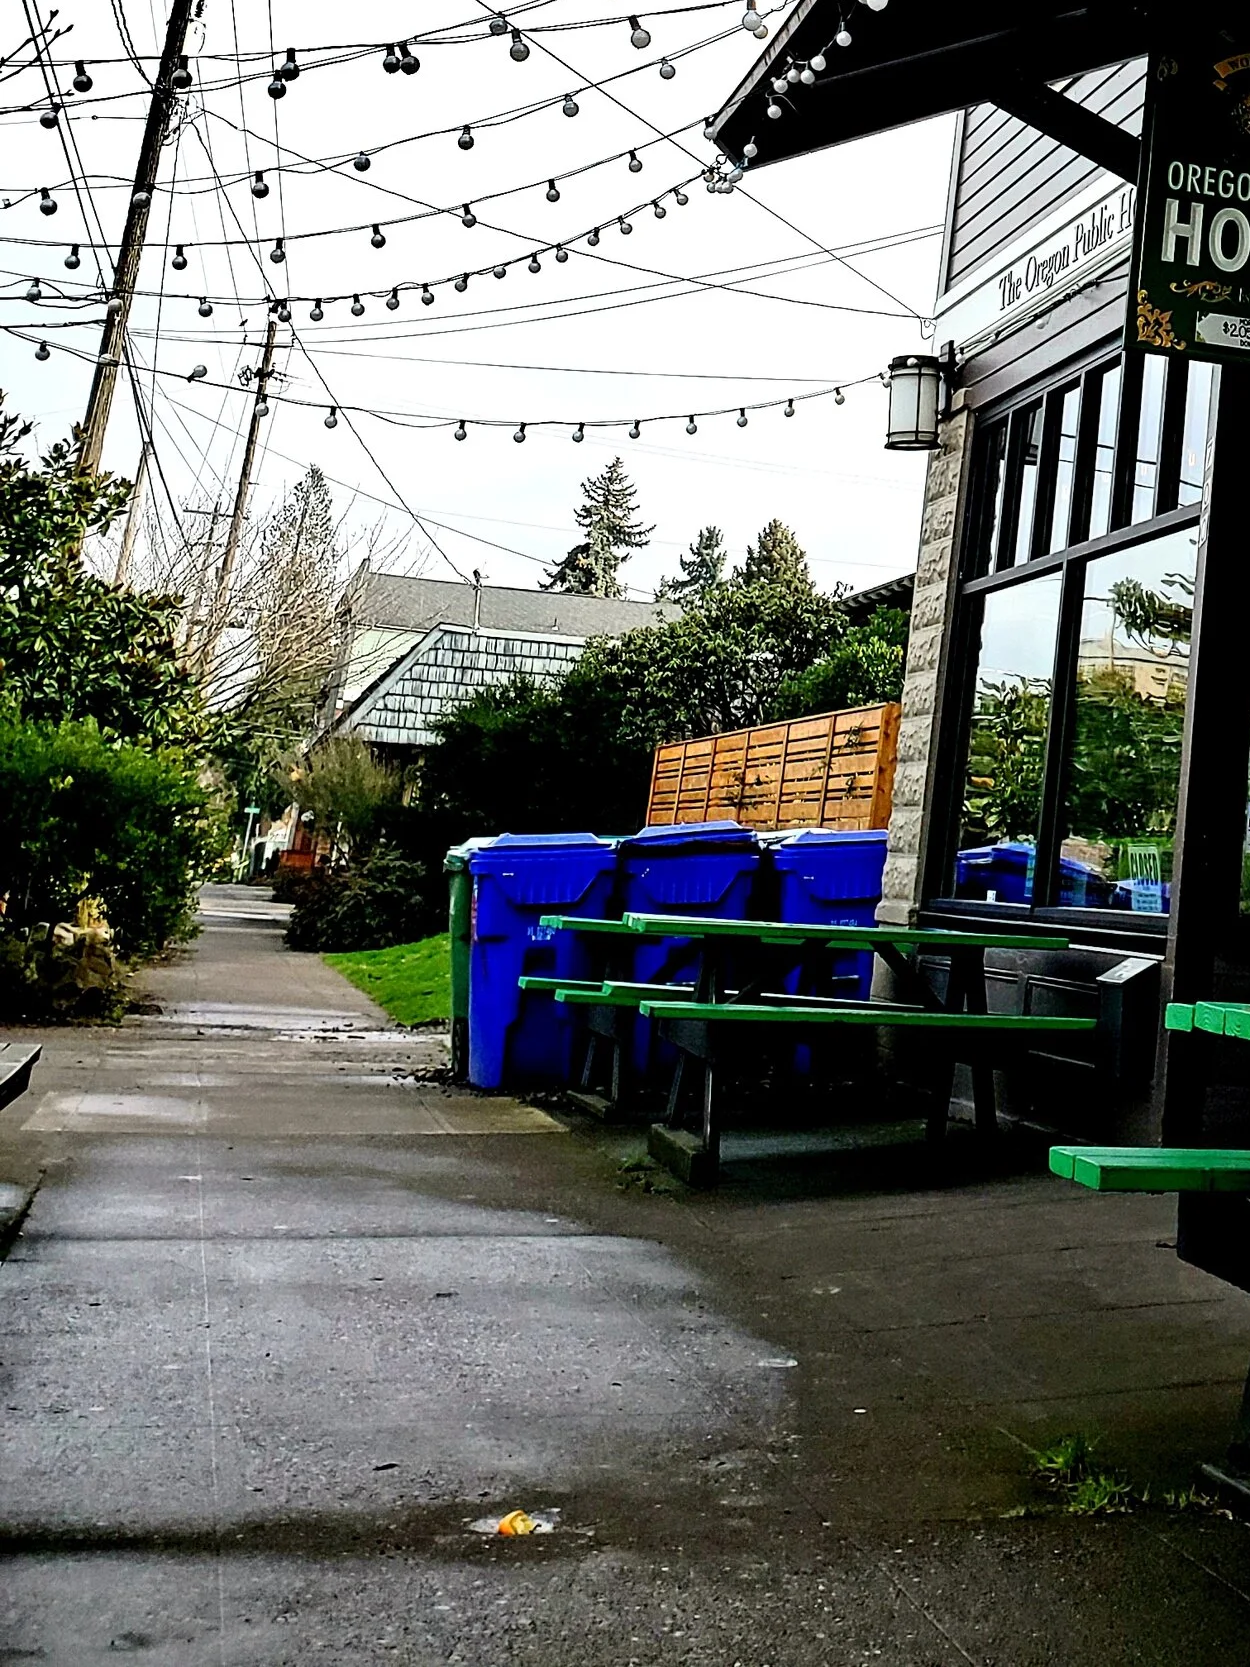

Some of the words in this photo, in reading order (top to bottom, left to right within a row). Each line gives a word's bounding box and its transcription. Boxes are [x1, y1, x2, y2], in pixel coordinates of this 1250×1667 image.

[999, 270, 1023, 312] The
[1025, 245, 1071, 289] Oregon
[1072, 204, 1115, 264] Public
[1117, 187, 1138, 235] H
[1130, 852, 1160, 886] CLOSED
